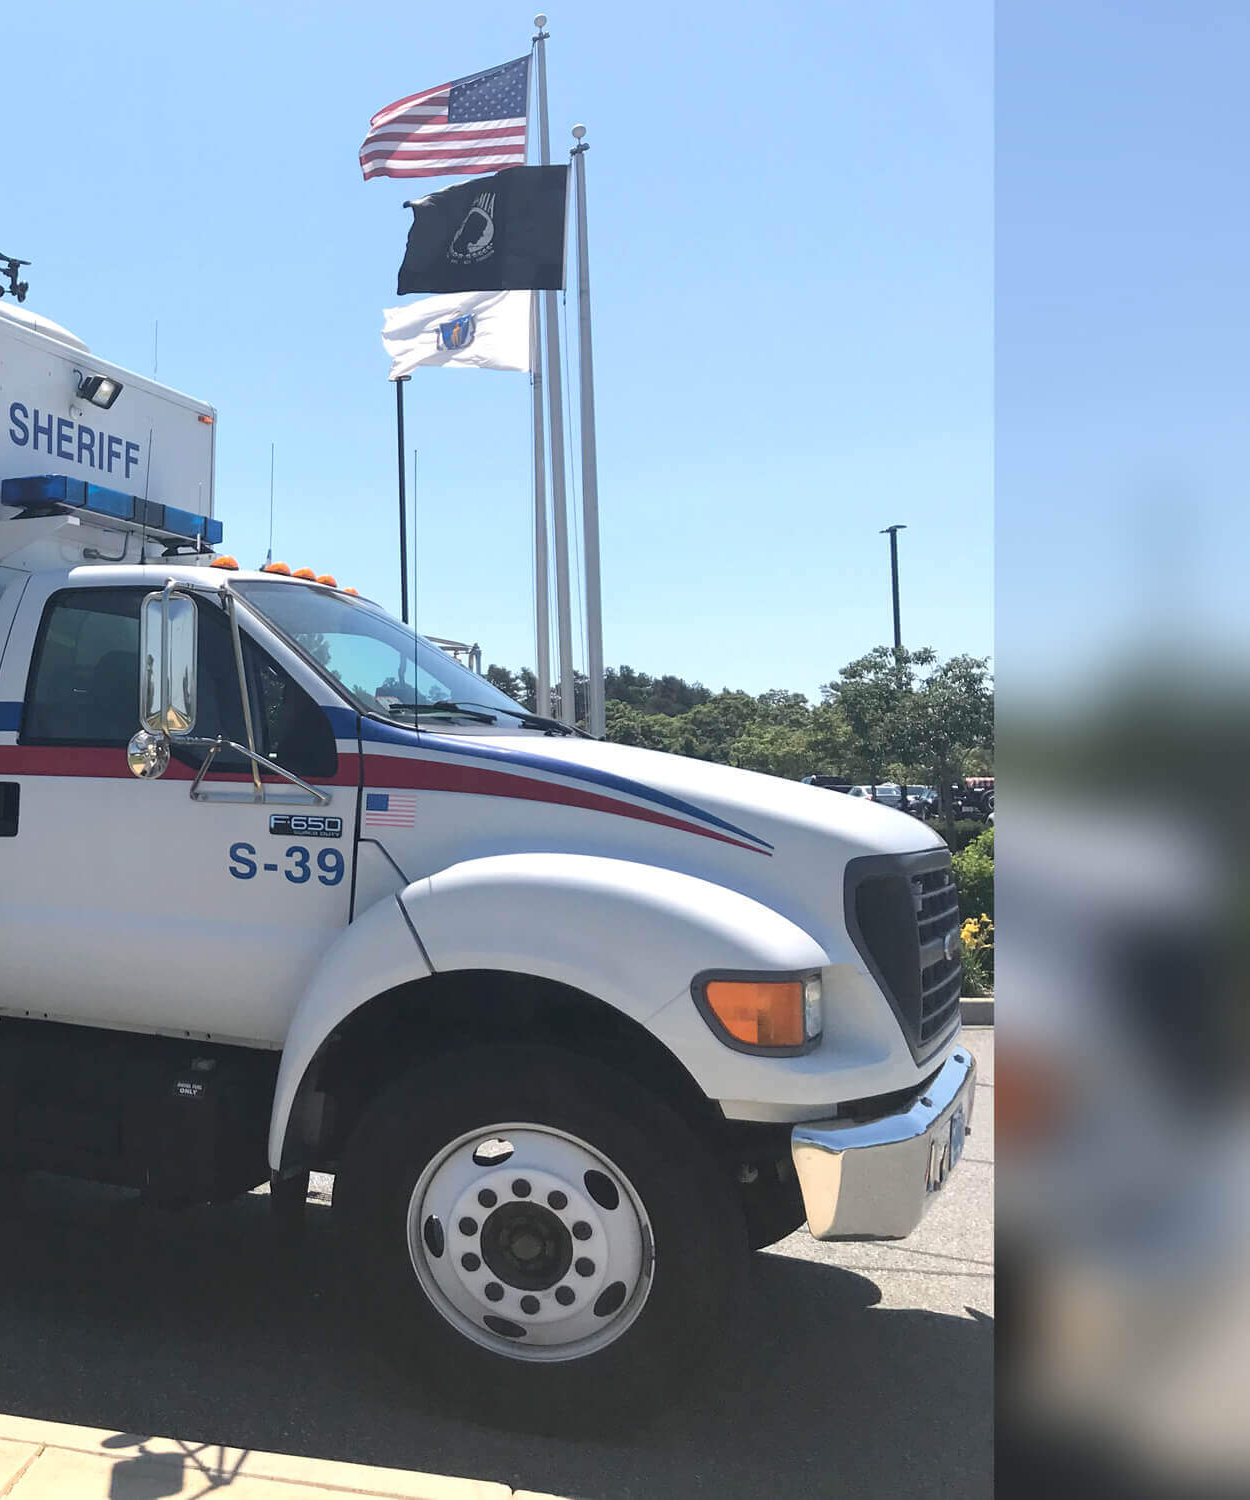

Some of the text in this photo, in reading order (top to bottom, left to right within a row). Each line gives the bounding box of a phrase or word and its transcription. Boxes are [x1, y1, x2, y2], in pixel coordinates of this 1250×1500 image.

[9, 402, 140, 479] SHERIFF
[229, 842, 345, 886] S-39
[179, 1087, 198, 1096] ONLY
